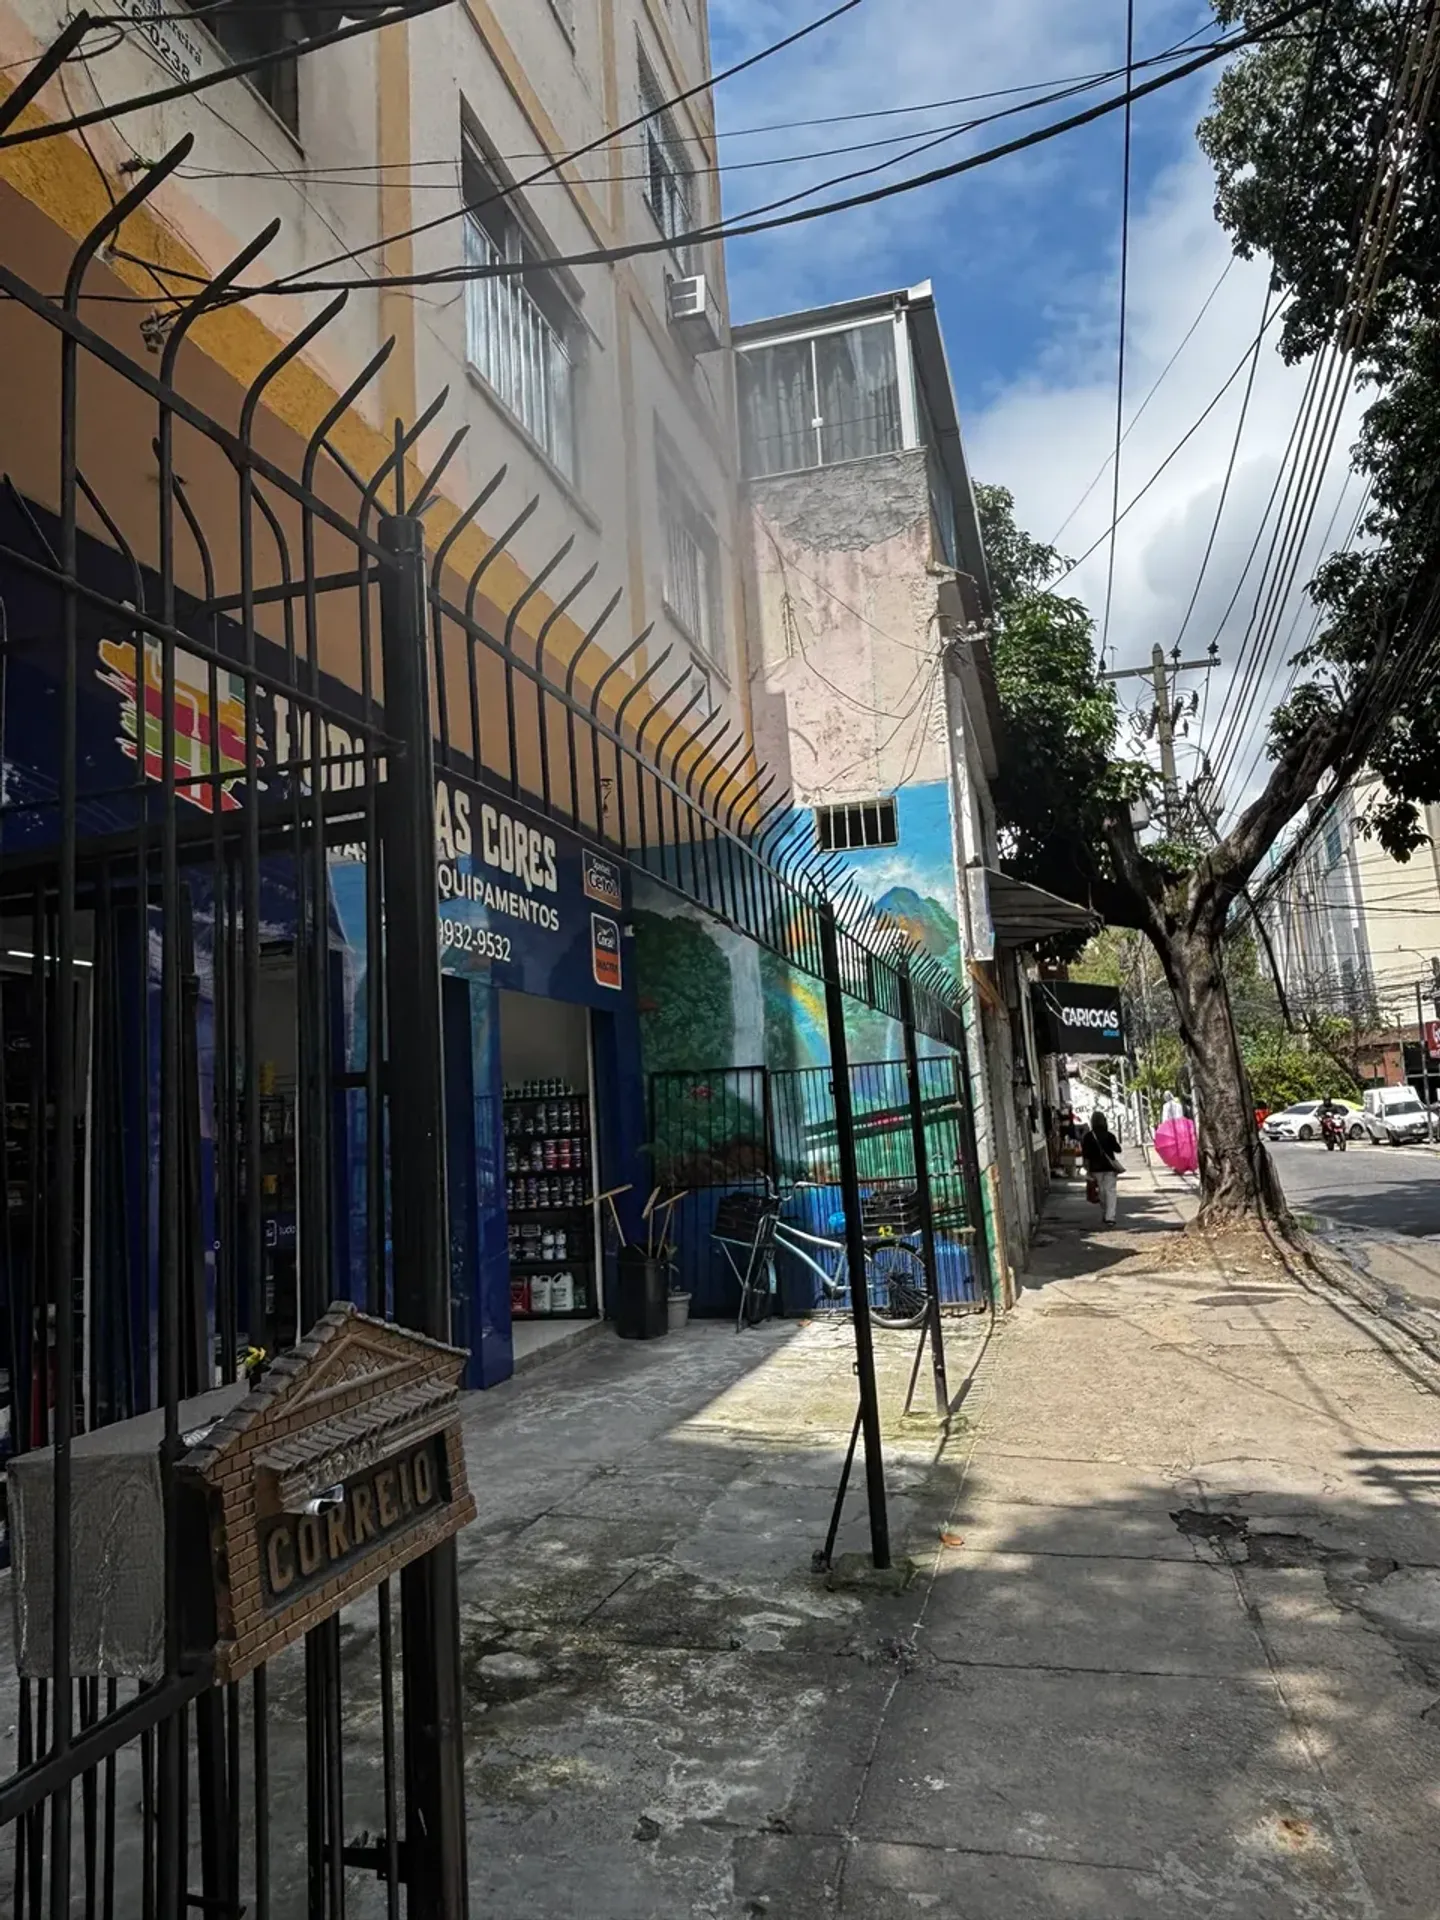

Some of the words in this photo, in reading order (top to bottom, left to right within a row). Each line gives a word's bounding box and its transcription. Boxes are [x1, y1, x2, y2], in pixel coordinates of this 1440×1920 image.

[434, 779, 472, 860] AS
[481, 803, 558, 893] CORES
[438, 863, 560, 932] QUIPAMENTOS
[1061, 1006, 1119, 1029] CARIOCAS
[267, 1450, 433, 1594] CORREIO
